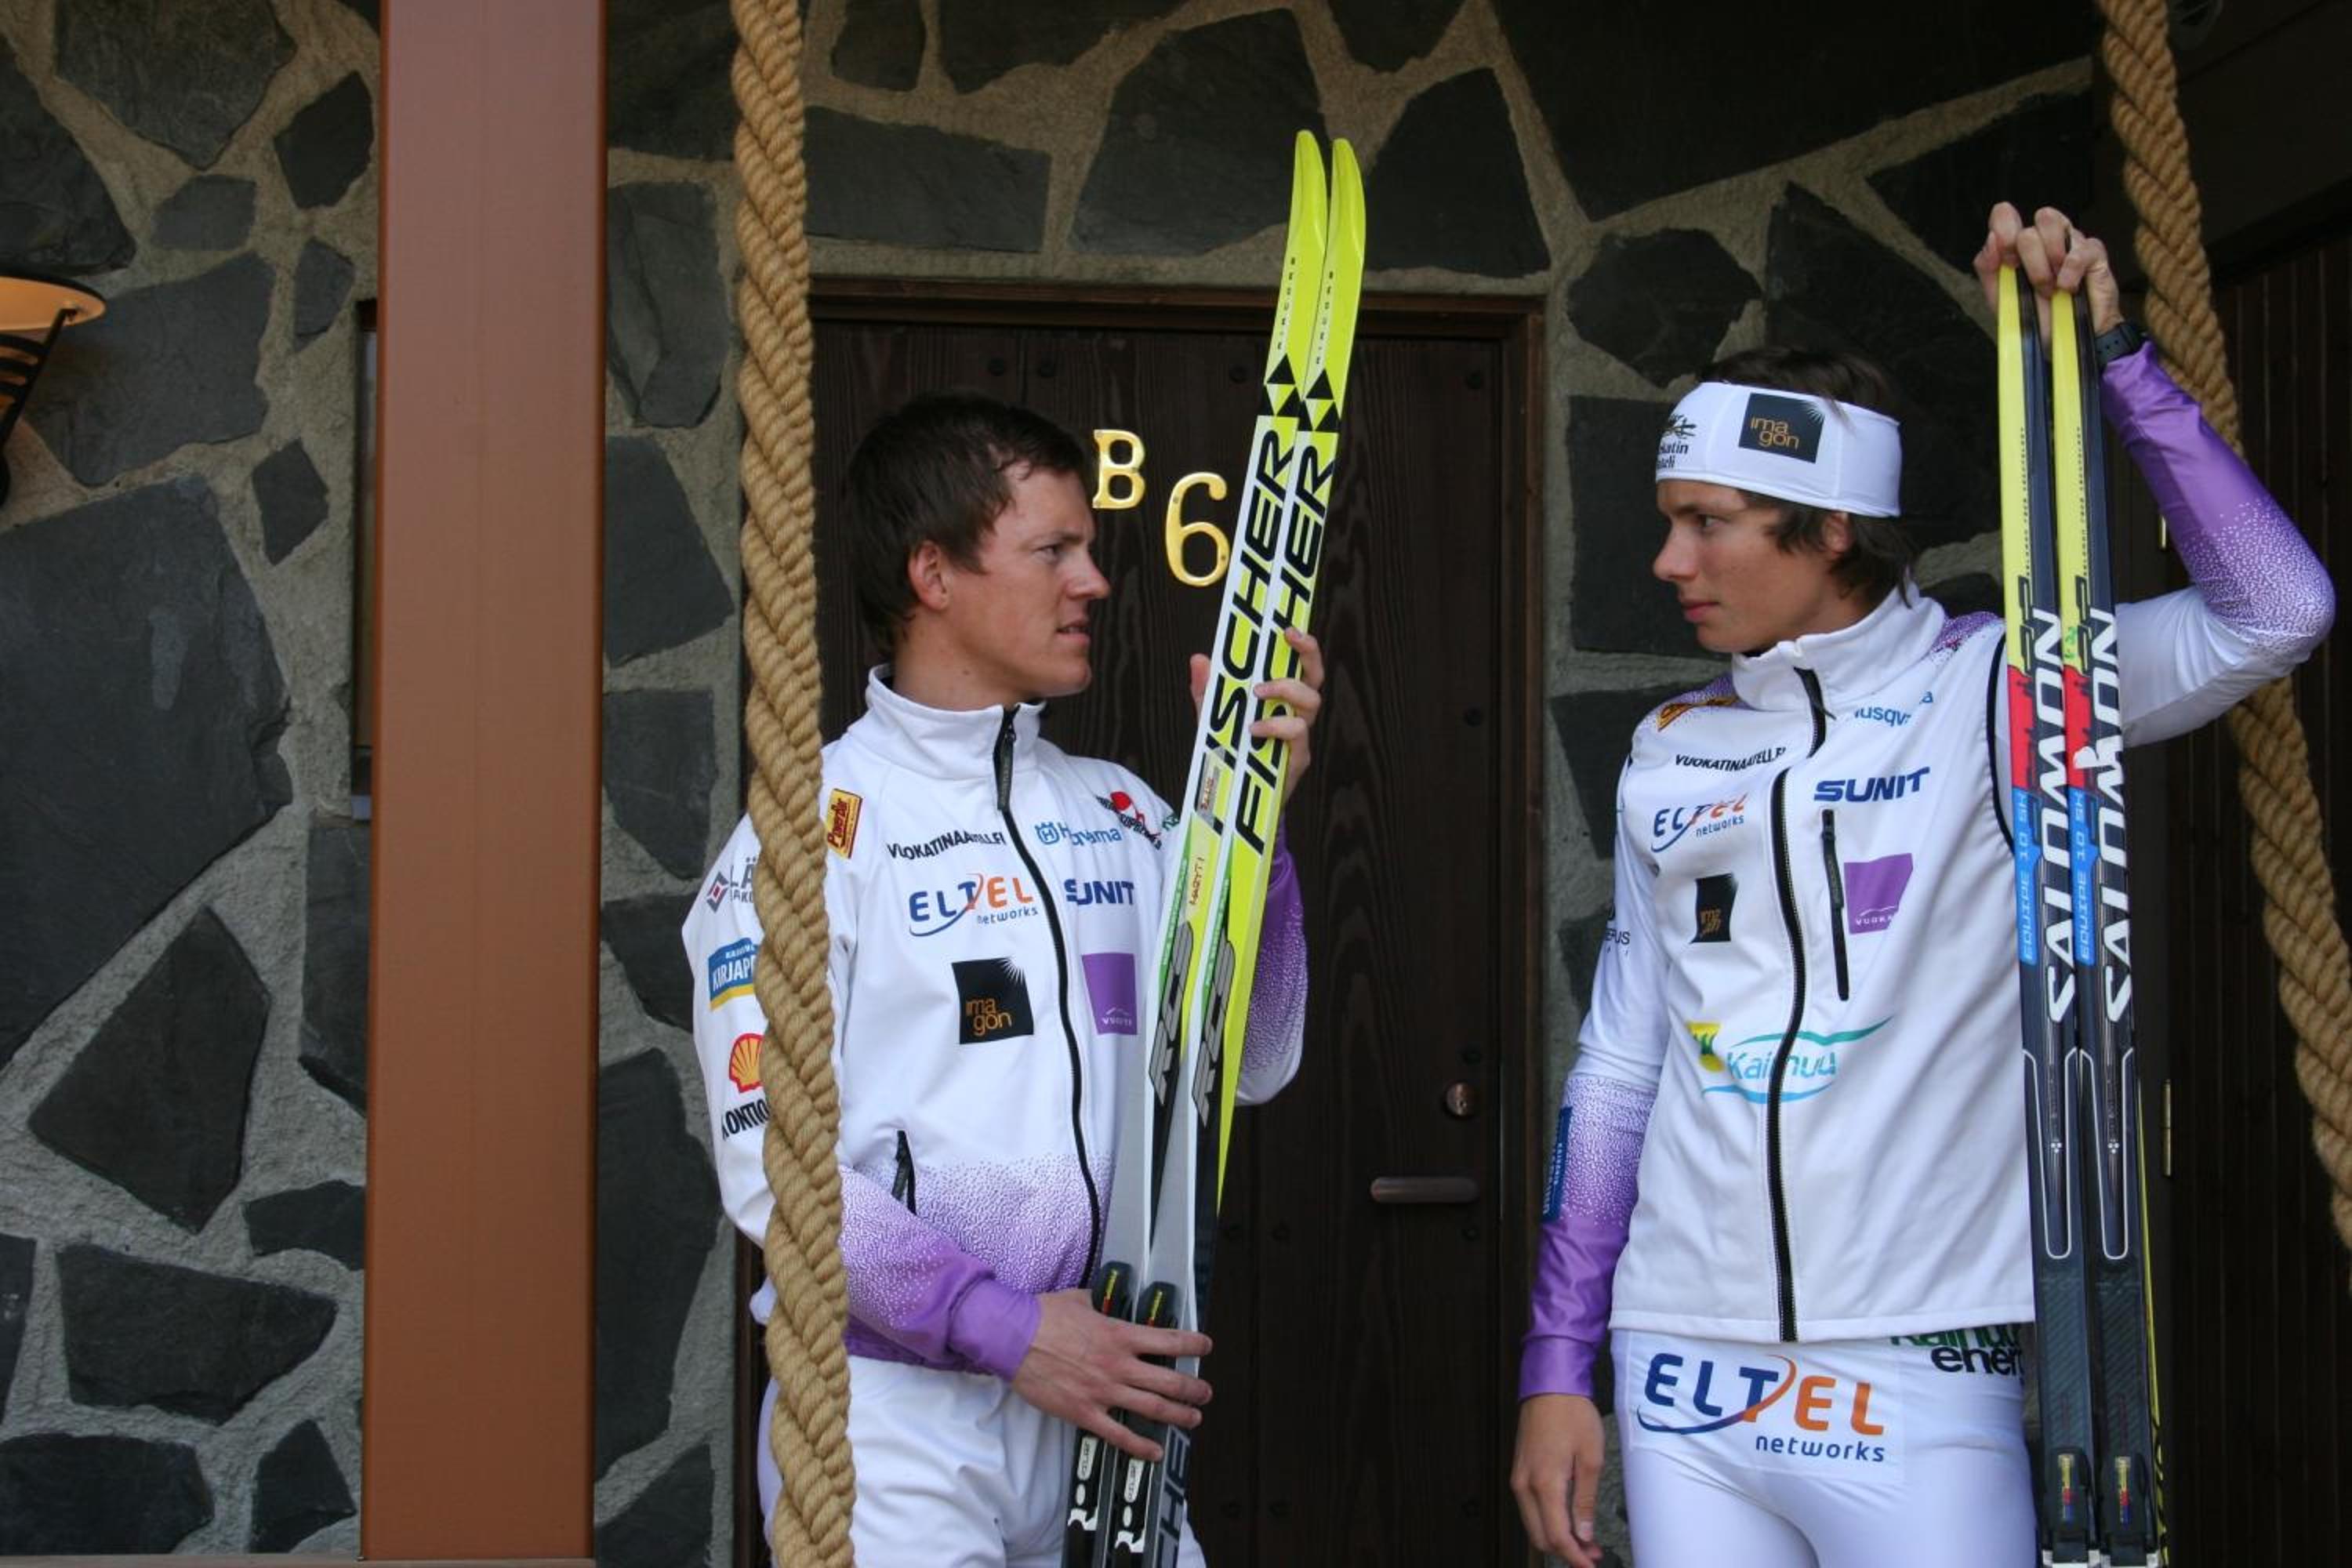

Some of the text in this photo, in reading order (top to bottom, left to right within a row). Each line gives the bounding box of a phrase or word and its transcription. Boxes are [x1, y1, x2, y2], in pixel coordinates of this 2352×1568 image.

[1759, 430, 1800, 450] gon
[1093, 429, 1229, 586] B 6
[1813, 766, 1931, 803] SUNIT
[1695, 815, 1744, 837] networks
[2032, 608, 2076, 1023] SALOMON
[908, 873, 1035, 923] ELTEL
[1064, 878, 1135, 906] SUNIT
[977, 906, 1039, 925] networks
[2020, 872, 2034, 960] EQUIPE
[2076, 872, 2090, 960] EQUIPE
[973, 1012, 1012, 1036] gon
[1645, 1352, 1886, 1436] ELTEL
[1755, 1434, 1886, 1463] networks
